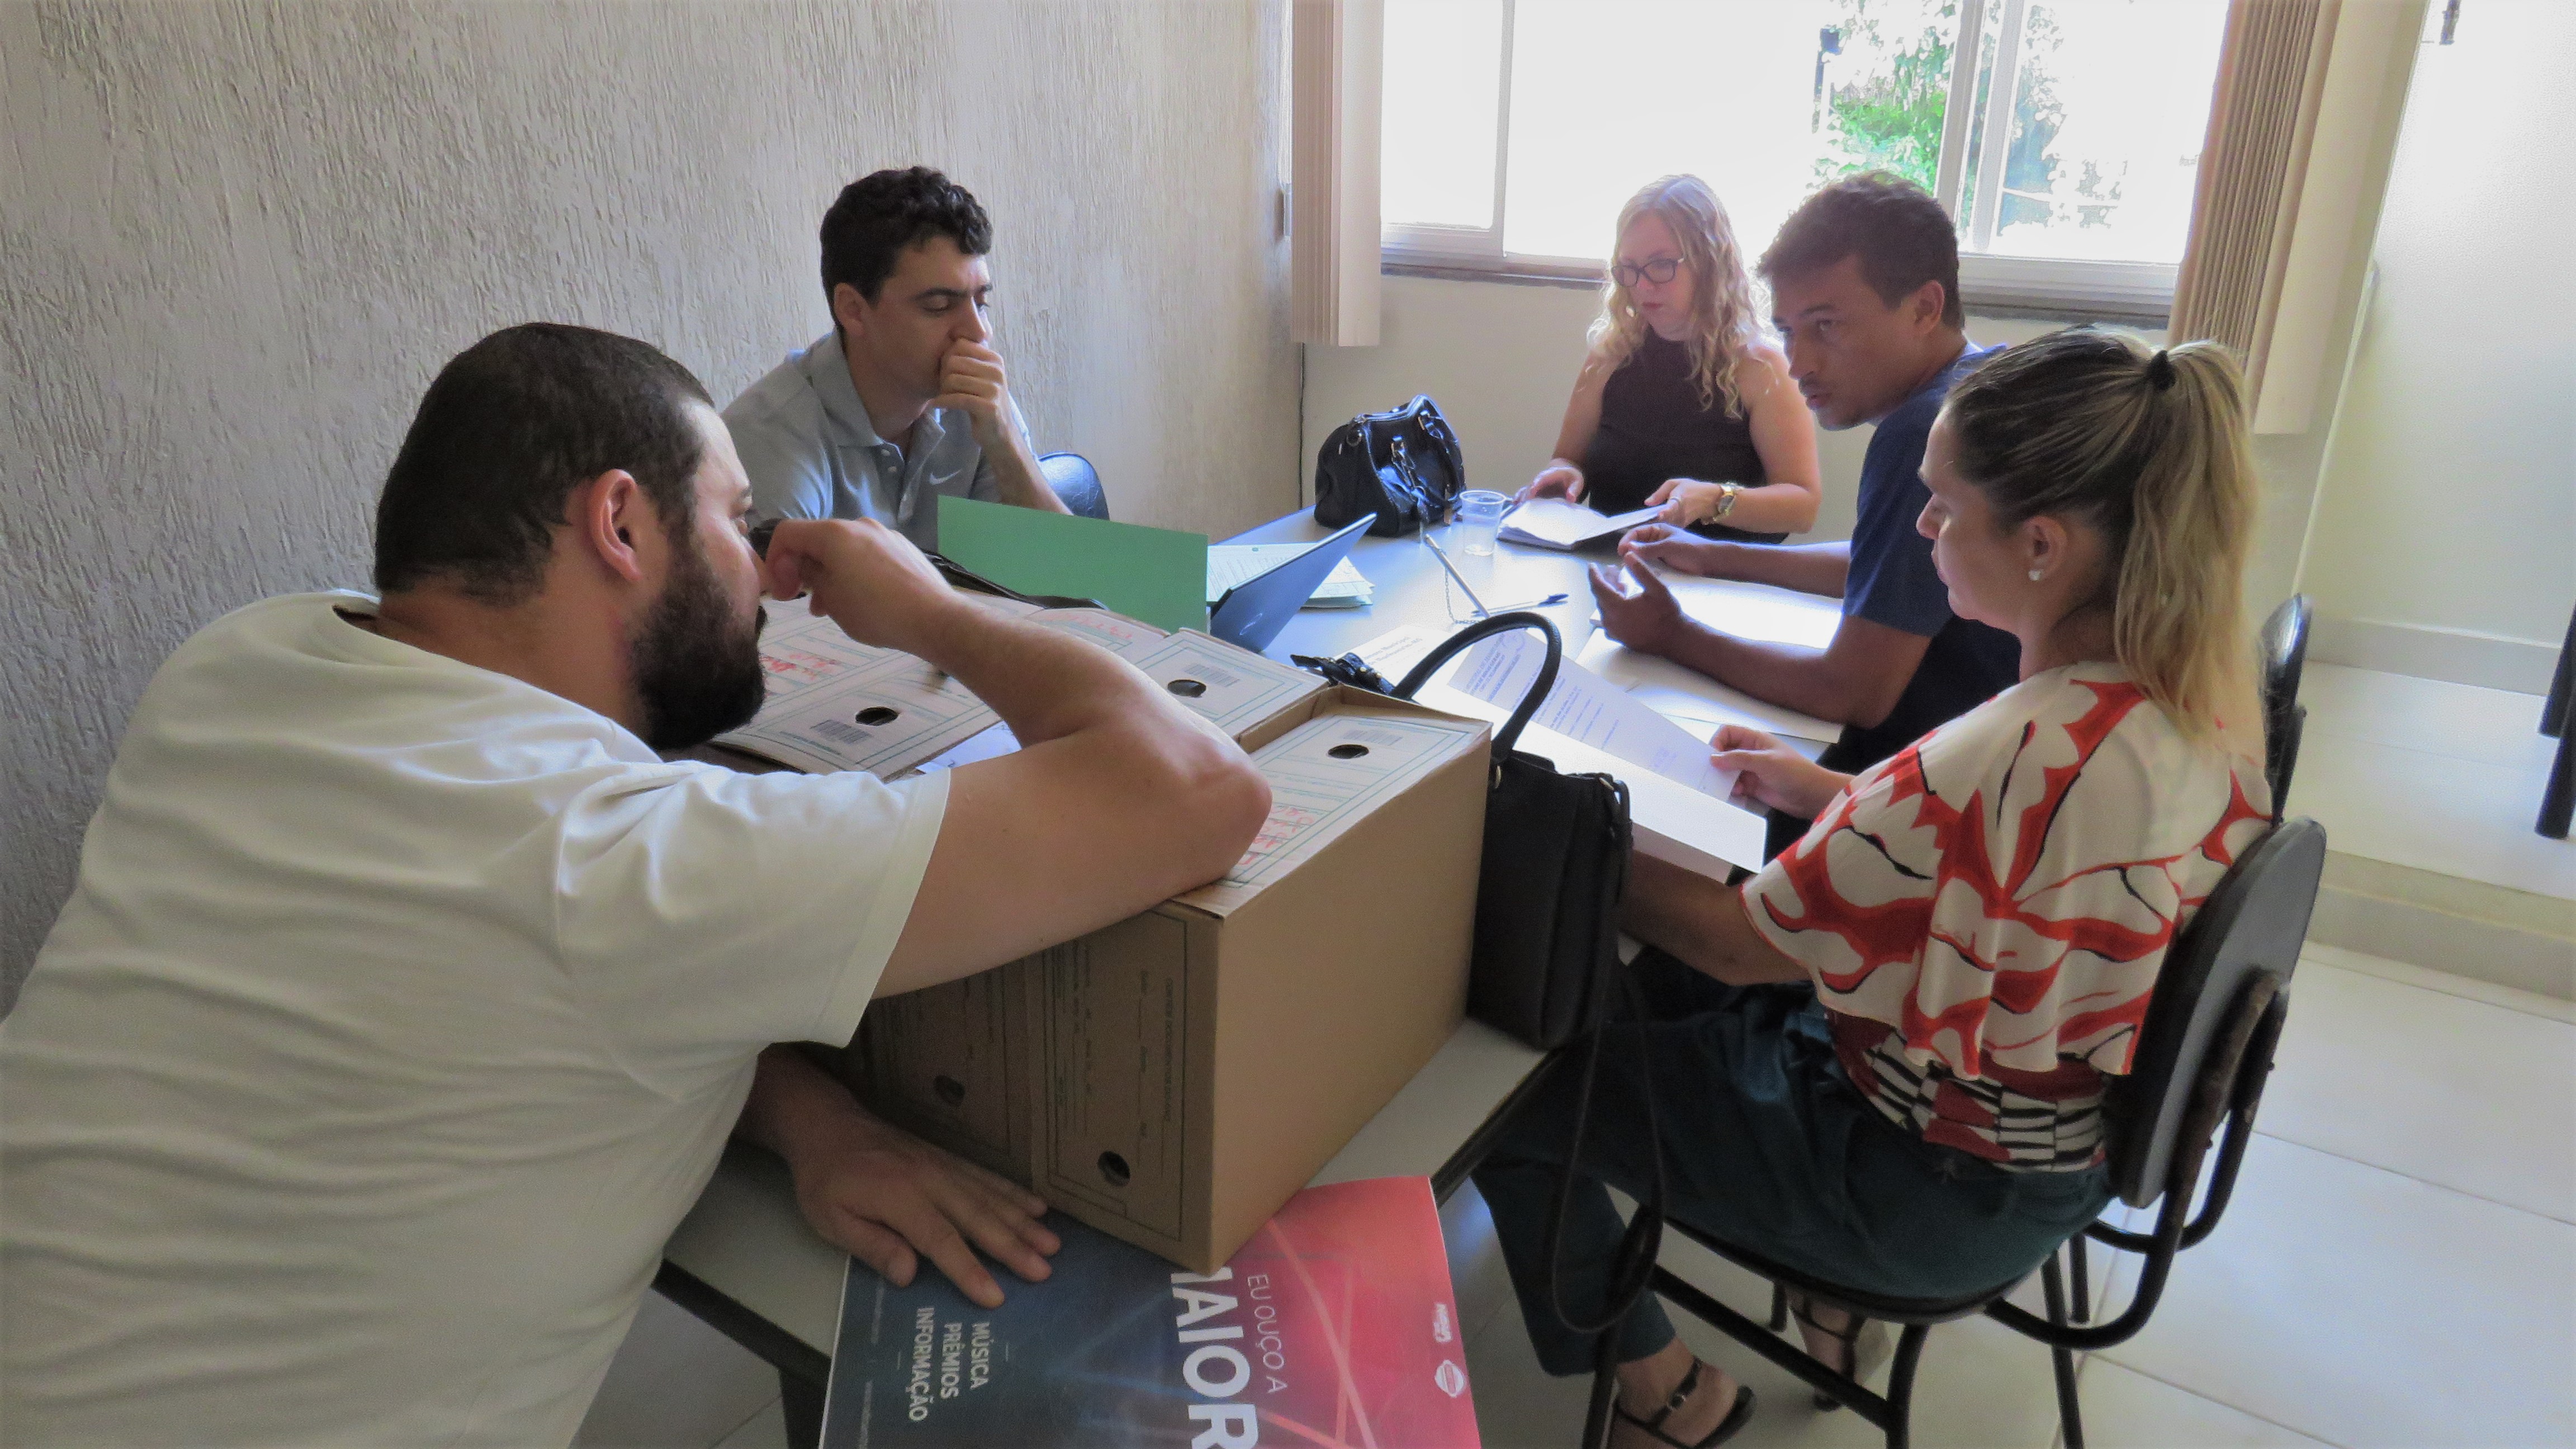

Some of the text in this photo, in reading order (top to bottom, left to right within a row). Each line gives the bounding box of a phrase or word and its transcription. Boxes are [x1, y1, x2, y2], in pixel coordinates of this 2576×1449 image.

[905, 1306, 935, 1422] INFORMAÇÃO
[940, 1322, 966, 1399] PRÊMIOS
[970, 1322, 995, 1390] MÚSICA
[1247, 1273, 1288, 1394] EU OUÇO A
